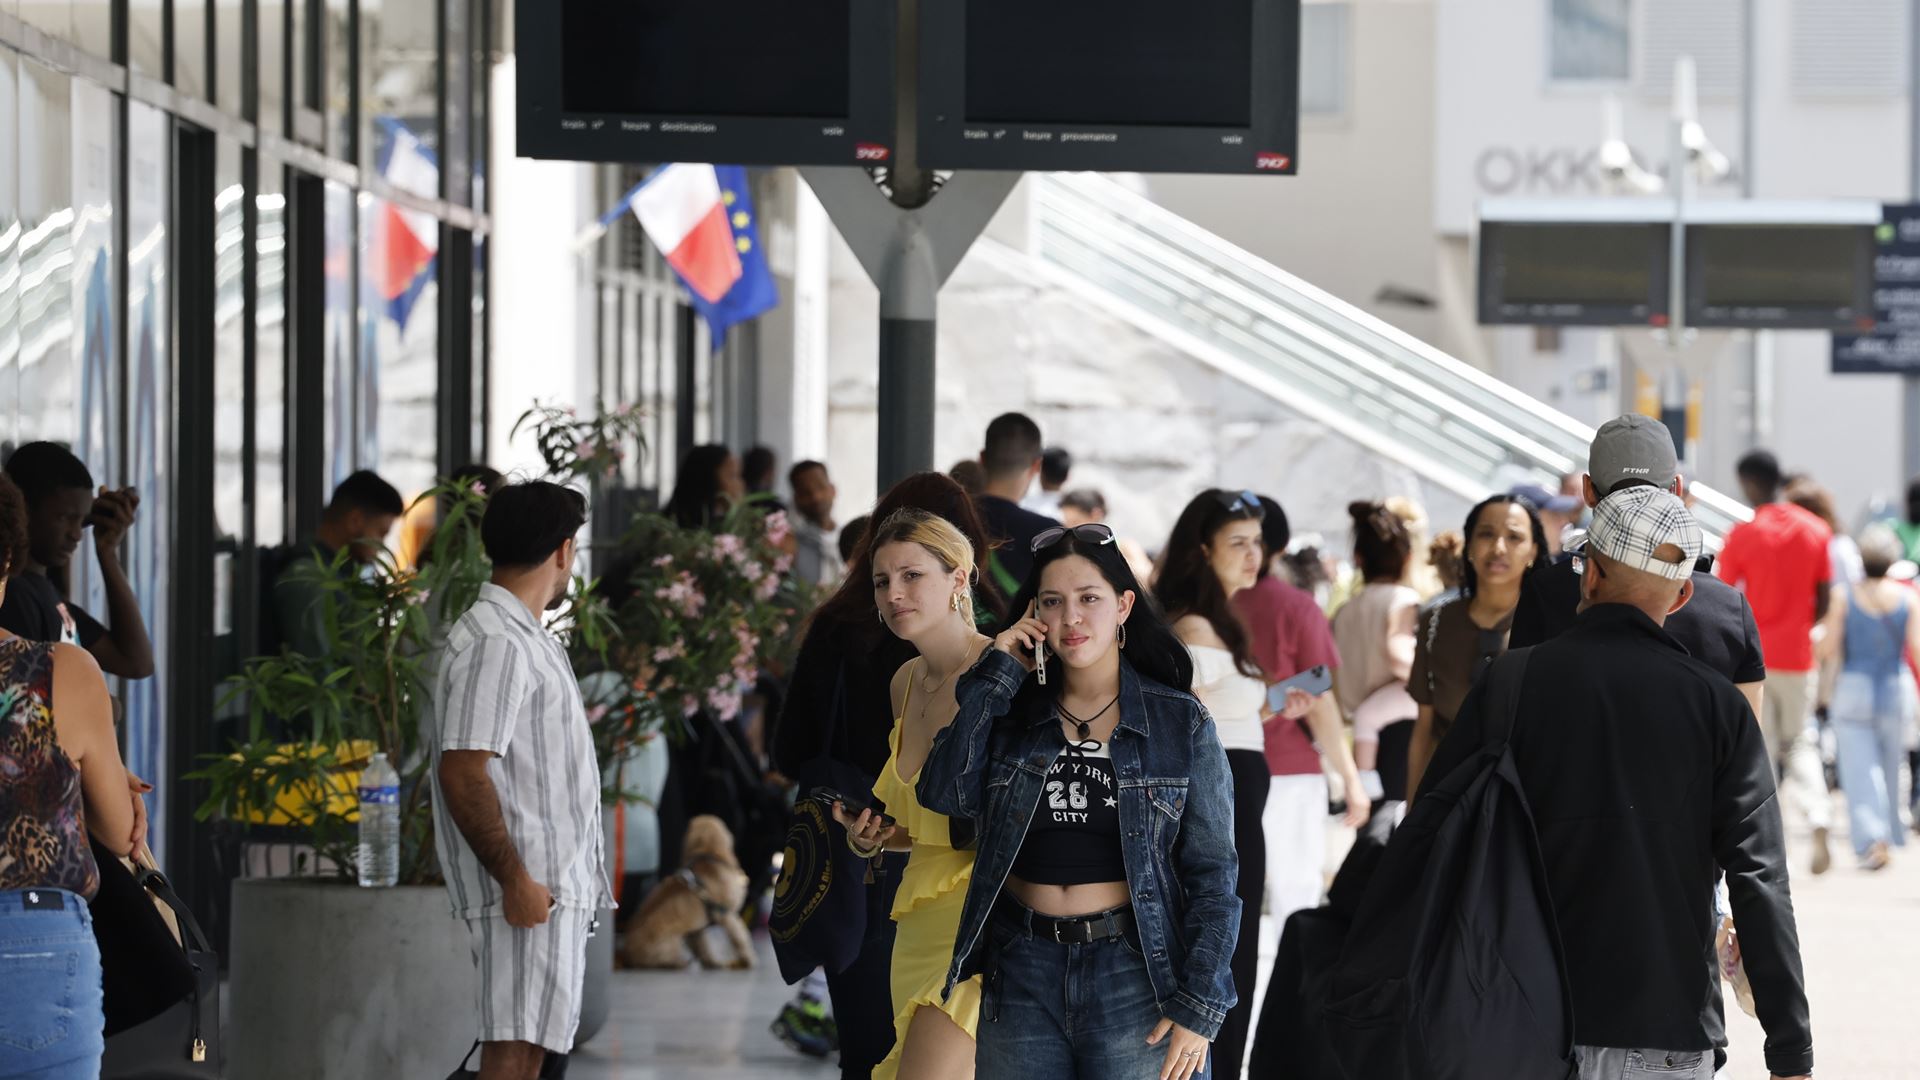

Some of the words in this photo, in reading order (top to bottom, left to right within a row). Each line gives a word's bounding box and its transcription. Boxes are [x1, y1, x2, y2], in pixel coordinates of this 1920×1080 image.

[561, 119, 587, 130] train
[621, 120, 651, 131] heure
[659, 121, 717, 133] destination
[822, 126, 845, 136] voie
[963, 129, 989, 140] train
[1022, 130, 1052, 141] heure
[1060, 131, 1118, 143] provenance
[1221, 134, 1244, 145] voie
[855, 147, 889, 160] SNCF
[1255, 157, 1289, 169] SNCF
[1475, 145, 1648, 195] OKK
[1053, 811, 1088, 823] CITY
